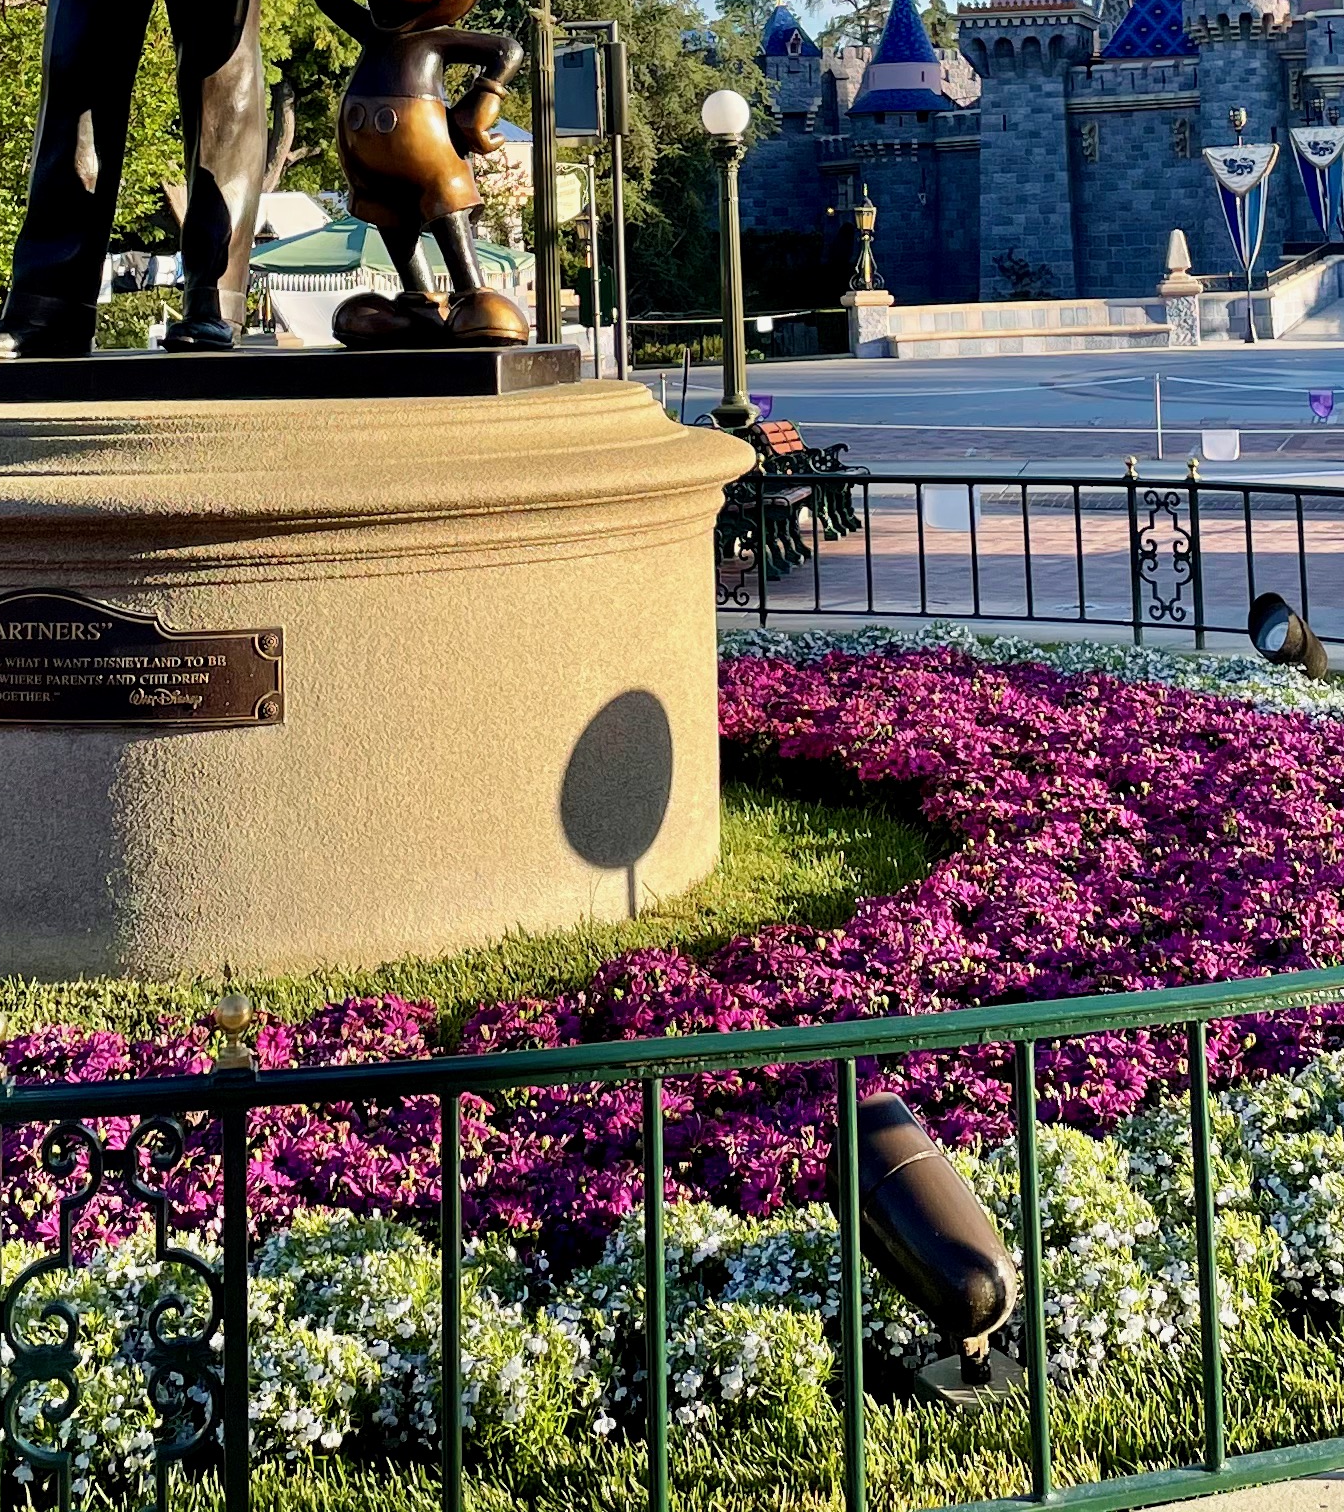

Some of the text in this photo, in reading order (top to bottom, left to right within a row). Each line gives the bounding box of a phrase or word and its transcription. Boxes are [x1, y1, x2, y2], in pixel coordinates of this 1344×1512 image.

[5, 657, 41, 669] WHAT
[44, 658, 49, 668] I
[53, 657, 91, 669] WANT
[94, 655, 181, 669] DISNEYLAND
[184, 656, 204, 668] TO
[208, 655, 227, 667] BE
[0, 674, 42, 685] WHERE
[46, 674, 103, 686] PARENTS
[107, 674, 136, 685] AND
[140, 672, 210, 685] CHILDREN
